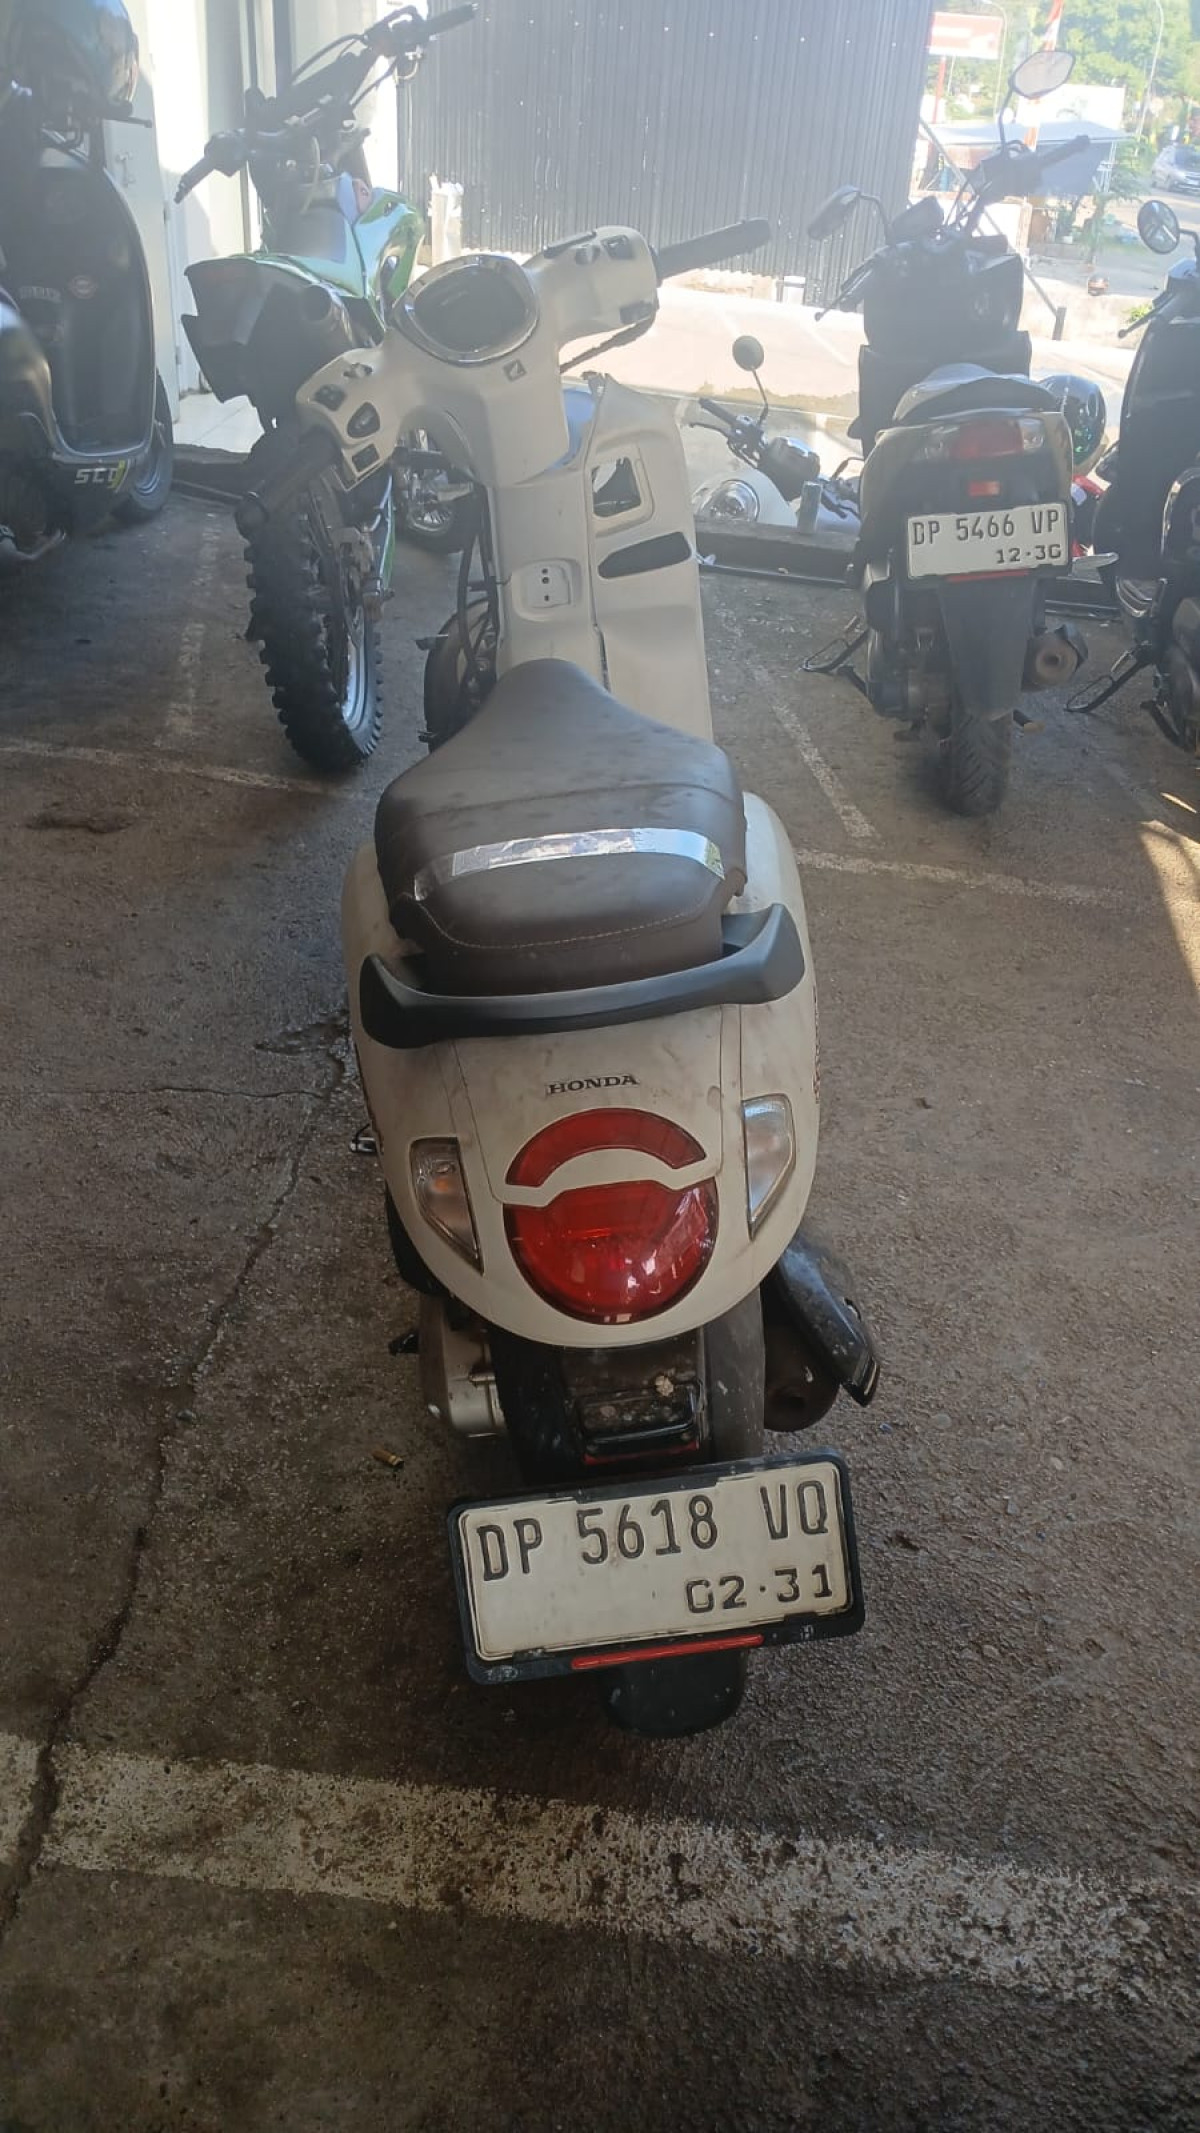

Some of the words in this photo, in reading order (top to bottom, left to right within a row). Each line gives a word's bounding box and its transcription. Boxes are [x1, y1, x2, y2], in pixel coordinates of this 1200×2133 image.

[912, 521, 941, 545] DP
[955, 513, 1015, 541] 5466
[1031, 510, 1059, 534] VP
[549, 1074, 640, 1095] HONDA
[477, 1516, 543, 1581] DP
[576, 1494, 719, 1565] 5618
[760, 1479, 829, 1541] VQ
